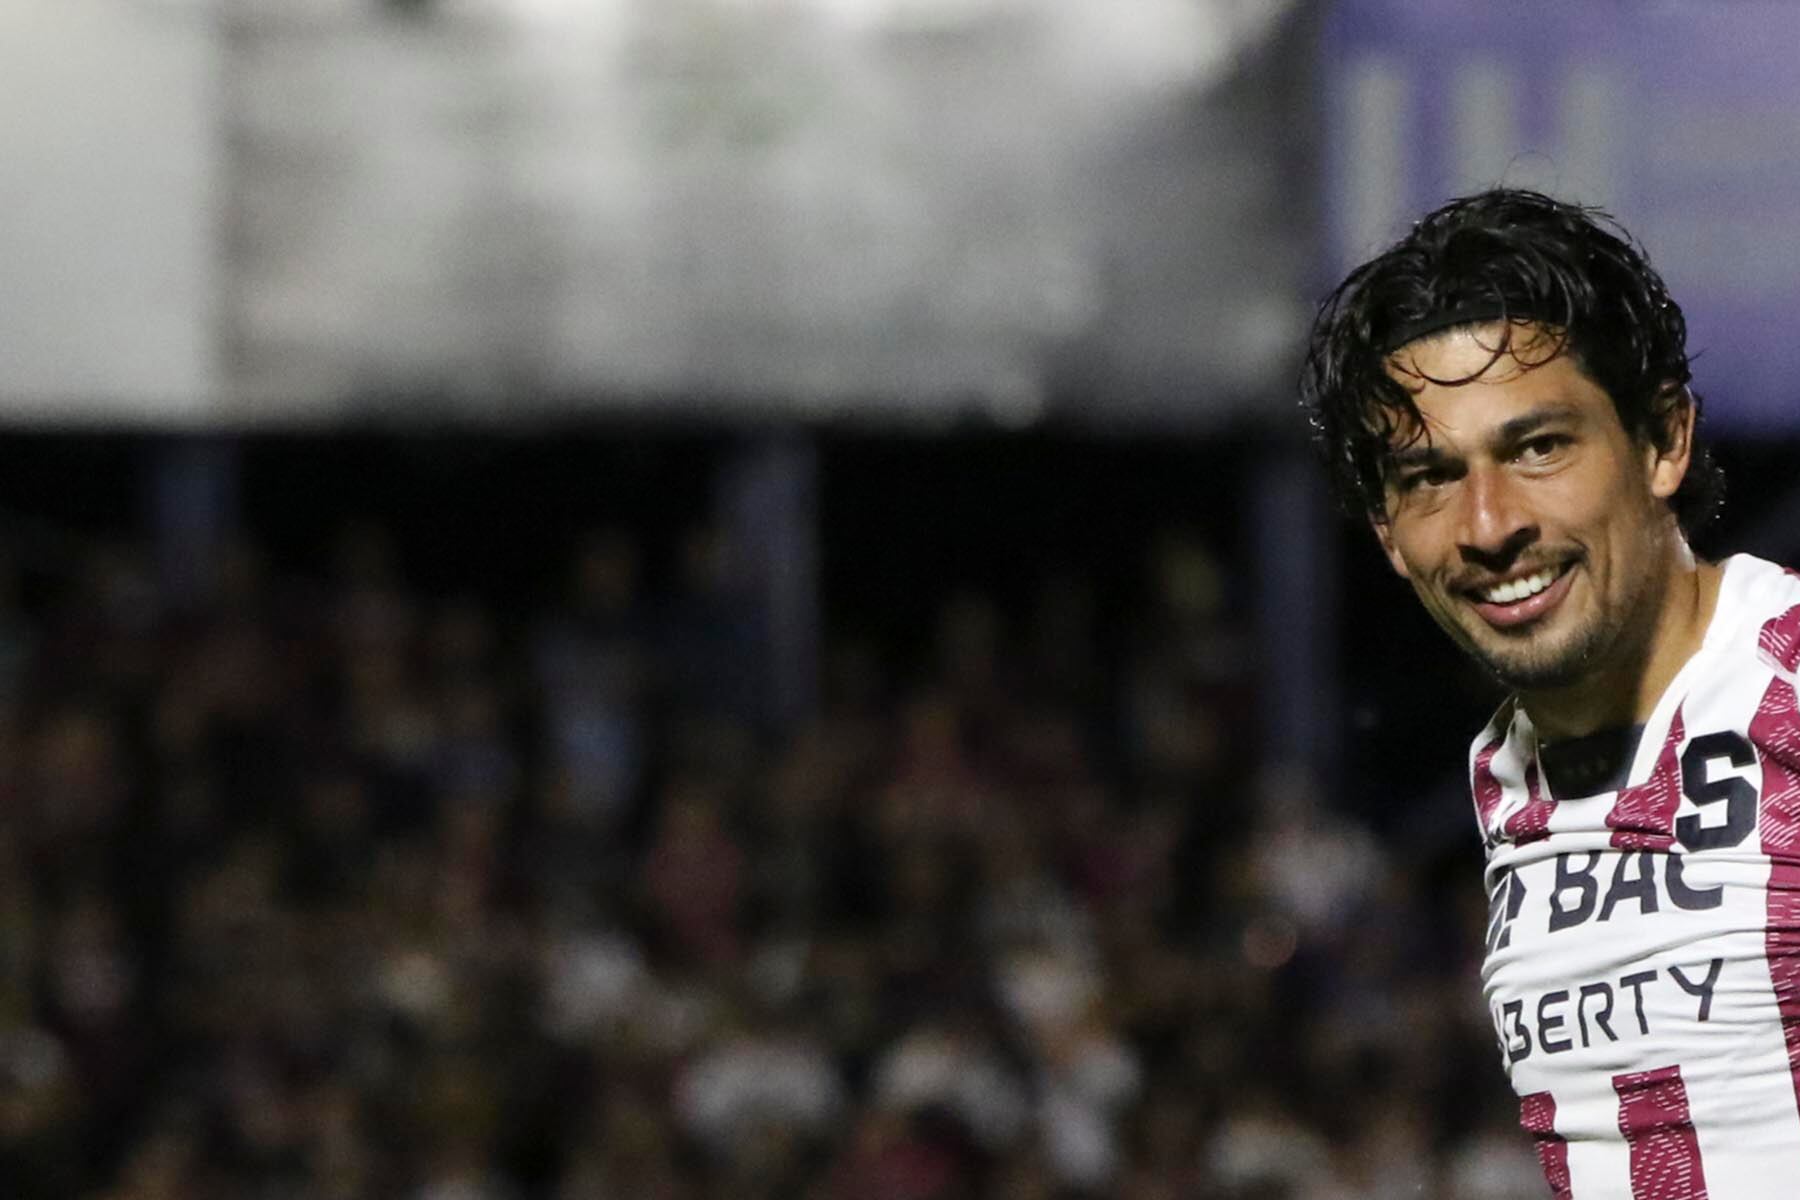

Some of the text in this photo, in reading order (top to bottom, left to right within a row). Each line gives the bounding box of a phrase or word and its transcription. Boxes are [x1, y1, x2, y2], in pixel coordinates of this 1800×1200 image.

[1675, 729, 1759, 853] S
[1548, 850, 1724, 933] BAC
[1497, 957, 1724, 1063] BERTY
